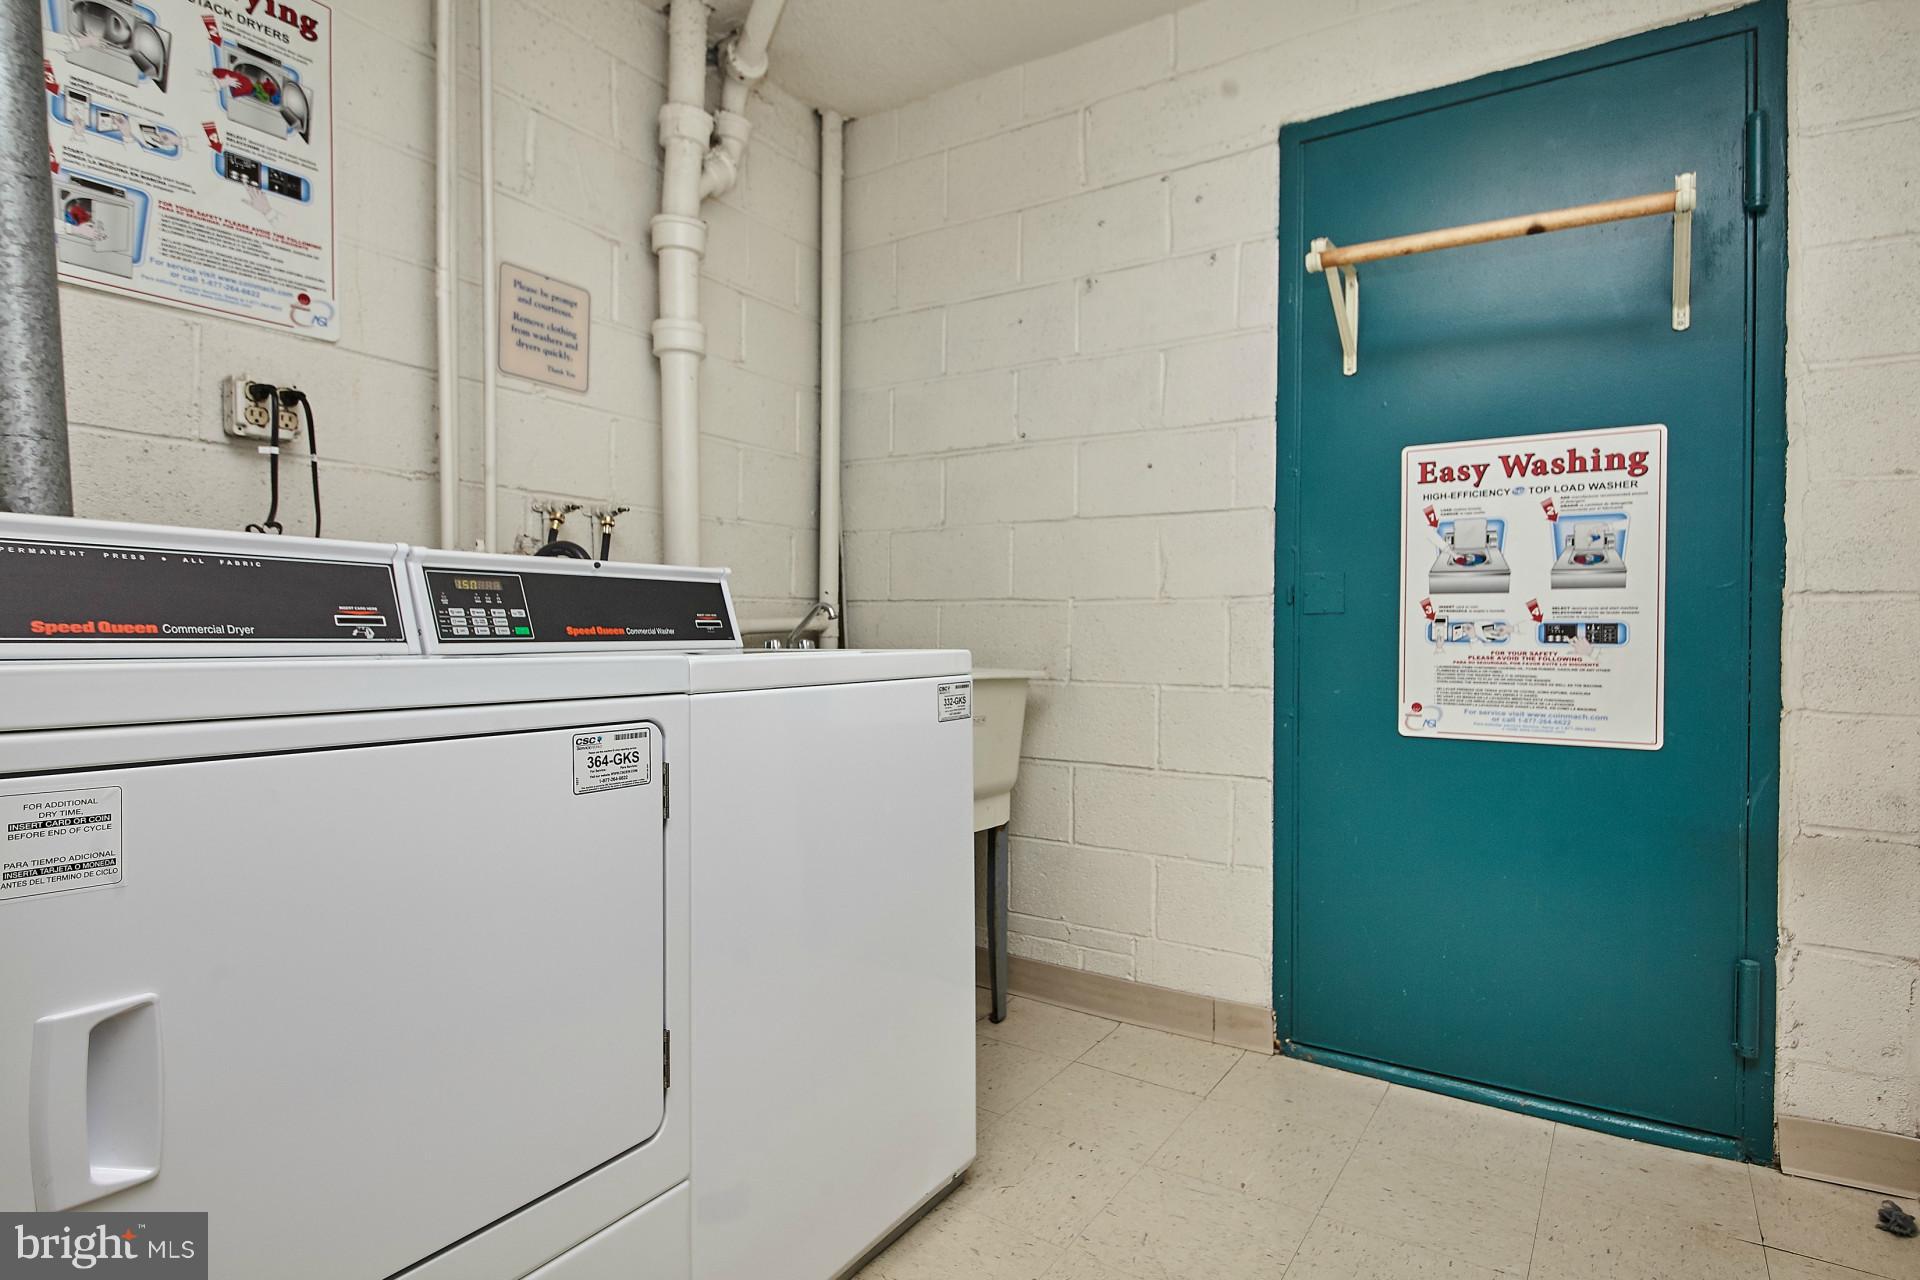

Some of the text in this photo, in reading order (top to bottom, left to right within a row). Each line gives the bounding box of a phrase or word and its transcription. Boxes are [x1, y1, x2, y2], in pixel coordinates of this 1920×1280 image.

[188, 0, 232, 19] TACK
[237, 13, 290, 44] DRYERS
[245, 0, 318, 42] ying
[208, 25, 218, 36] 2
[150, 256, 164, 267] For
[166, 261, 196, 275] service
[199, 269, 216, 279] visit
[182, 273, 198, 282] call
[513, 279, 578, 308] Please be prompt
[517, 296, 532, 306] and
[512, 311, 577, 340] Remove clothing
[511, 324, 578, 351] from washers and
[516, 338, 541, 353] dryers
[546, 364, 563, 375] Thank
[1417, 448, 1649, 488] Easy Washing
[1423, 487, 1511, 501] HIGH-EFFICIENCY
[1528, 485, 1550, 495] TOP
[1554, 483, 1585, 494] LOAD
[1589, 479, 1638, 491] WASHER
[1546, 506, 1555, 516] 2
[0, 546, 261, 567] PERMANENT PRESS ALL FABRIC
[1425, 605, 1433, 615] 3
[30, 620, 255, 637] Speed Queen Commercial Dryer
[566, 626, 596, 637] Speed
[597, 626, 625, 635] Queen
[1479, 709, 1506, 717] service
[576, 737, 596, 745] CSC
[587, 751, 640, 768] 364-GKS
[23, 798, 98, 811] FOR ADDITIONAL
[38, 808, 84, 819] DRY TIME,
[9, 822, 43, 832] INSERT
[45, 819, 71, 828] CARD
[88, 814, 111, 823] COIN
[7, 823, 112, 841] BEFORE END OF CYCLE
[3, 850, 116, 870] PARA TIEMPO ADICIONAL
[4, 869, 38, 880] INSERTA
[40, 864, 72, 874] TARJETA
[82, 859, 115, 869] MONEDA
[0, 880, 27, 890] ANTES
[29, 877, 45, 886] DEL
[47, 872, 82, 883] TERMINO
[96, 867, 118, 876] CICLO
